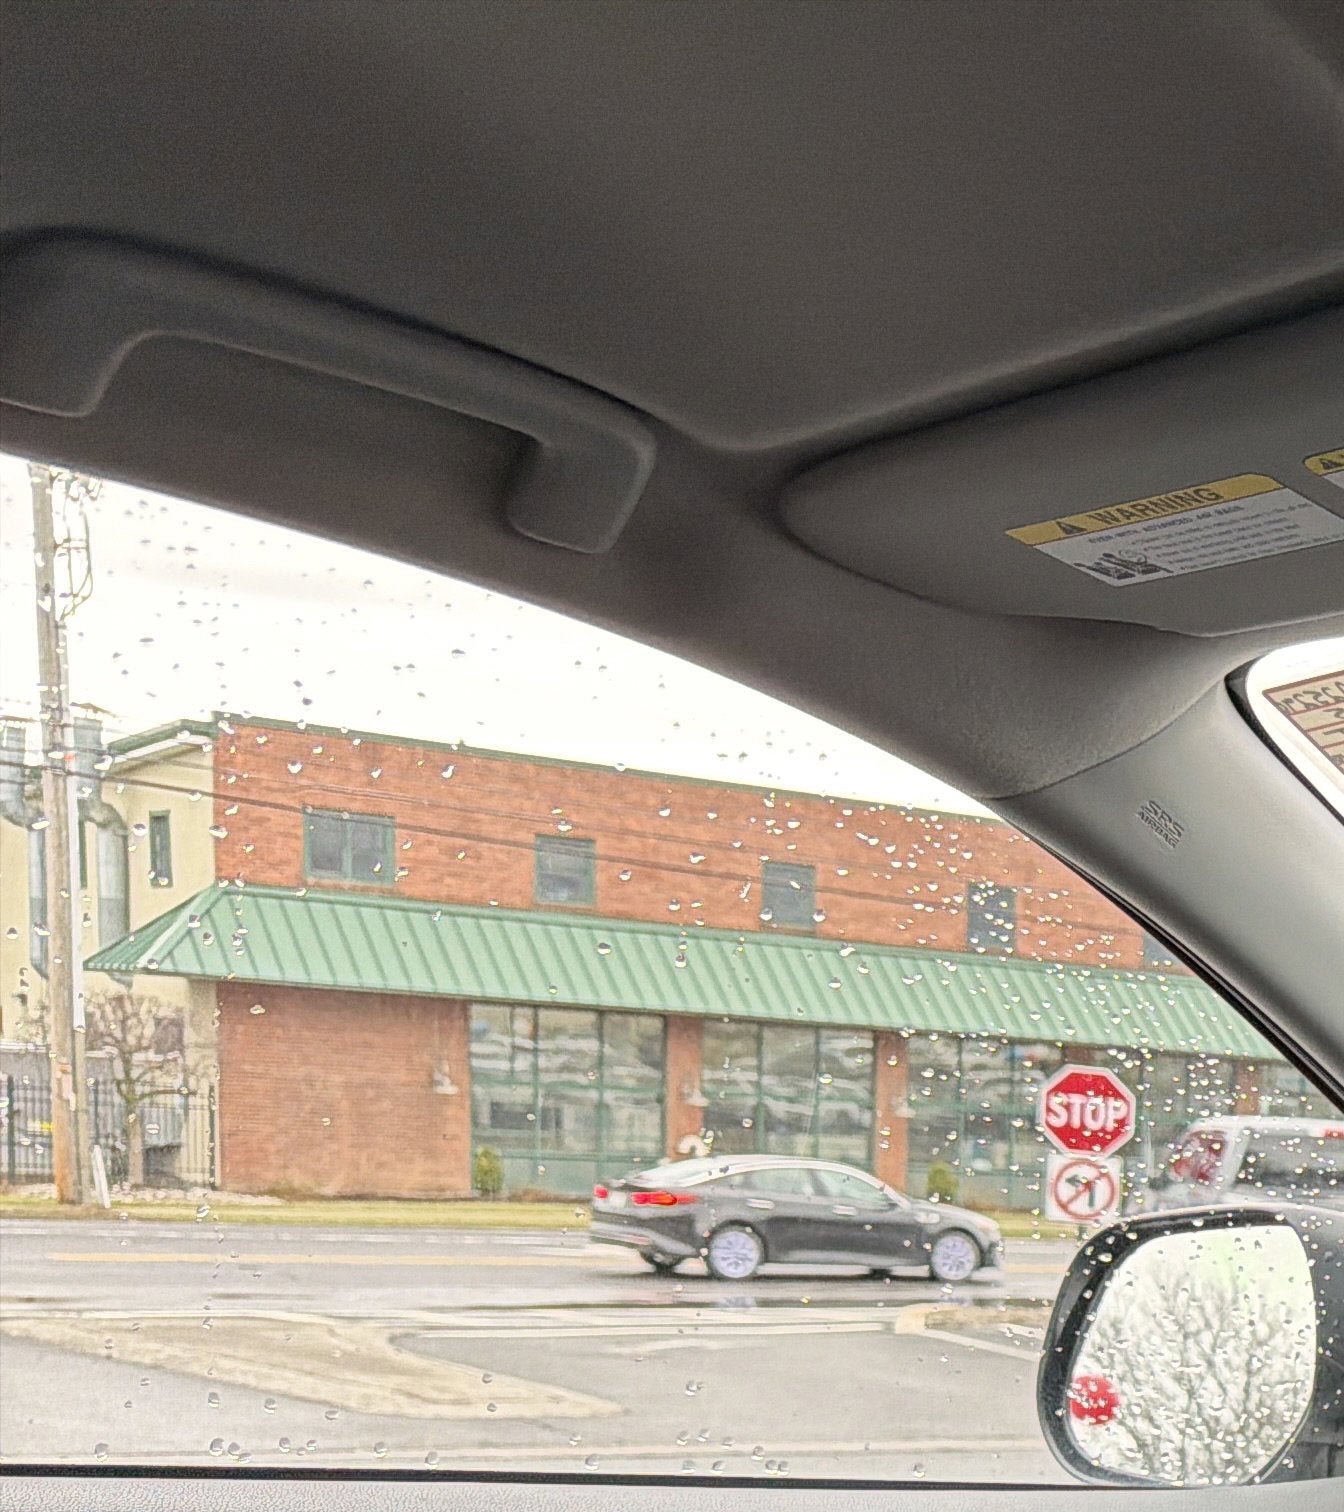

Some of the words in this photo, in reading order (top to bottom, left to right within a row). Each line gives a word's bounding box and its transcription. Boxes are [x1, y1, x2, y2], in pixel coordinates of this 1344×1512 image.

[1087, 488, 1224, 525] WARNING
[1141, 800, 1185, 837] SRS
[1047, 1091, 1128, 1132] STOP
